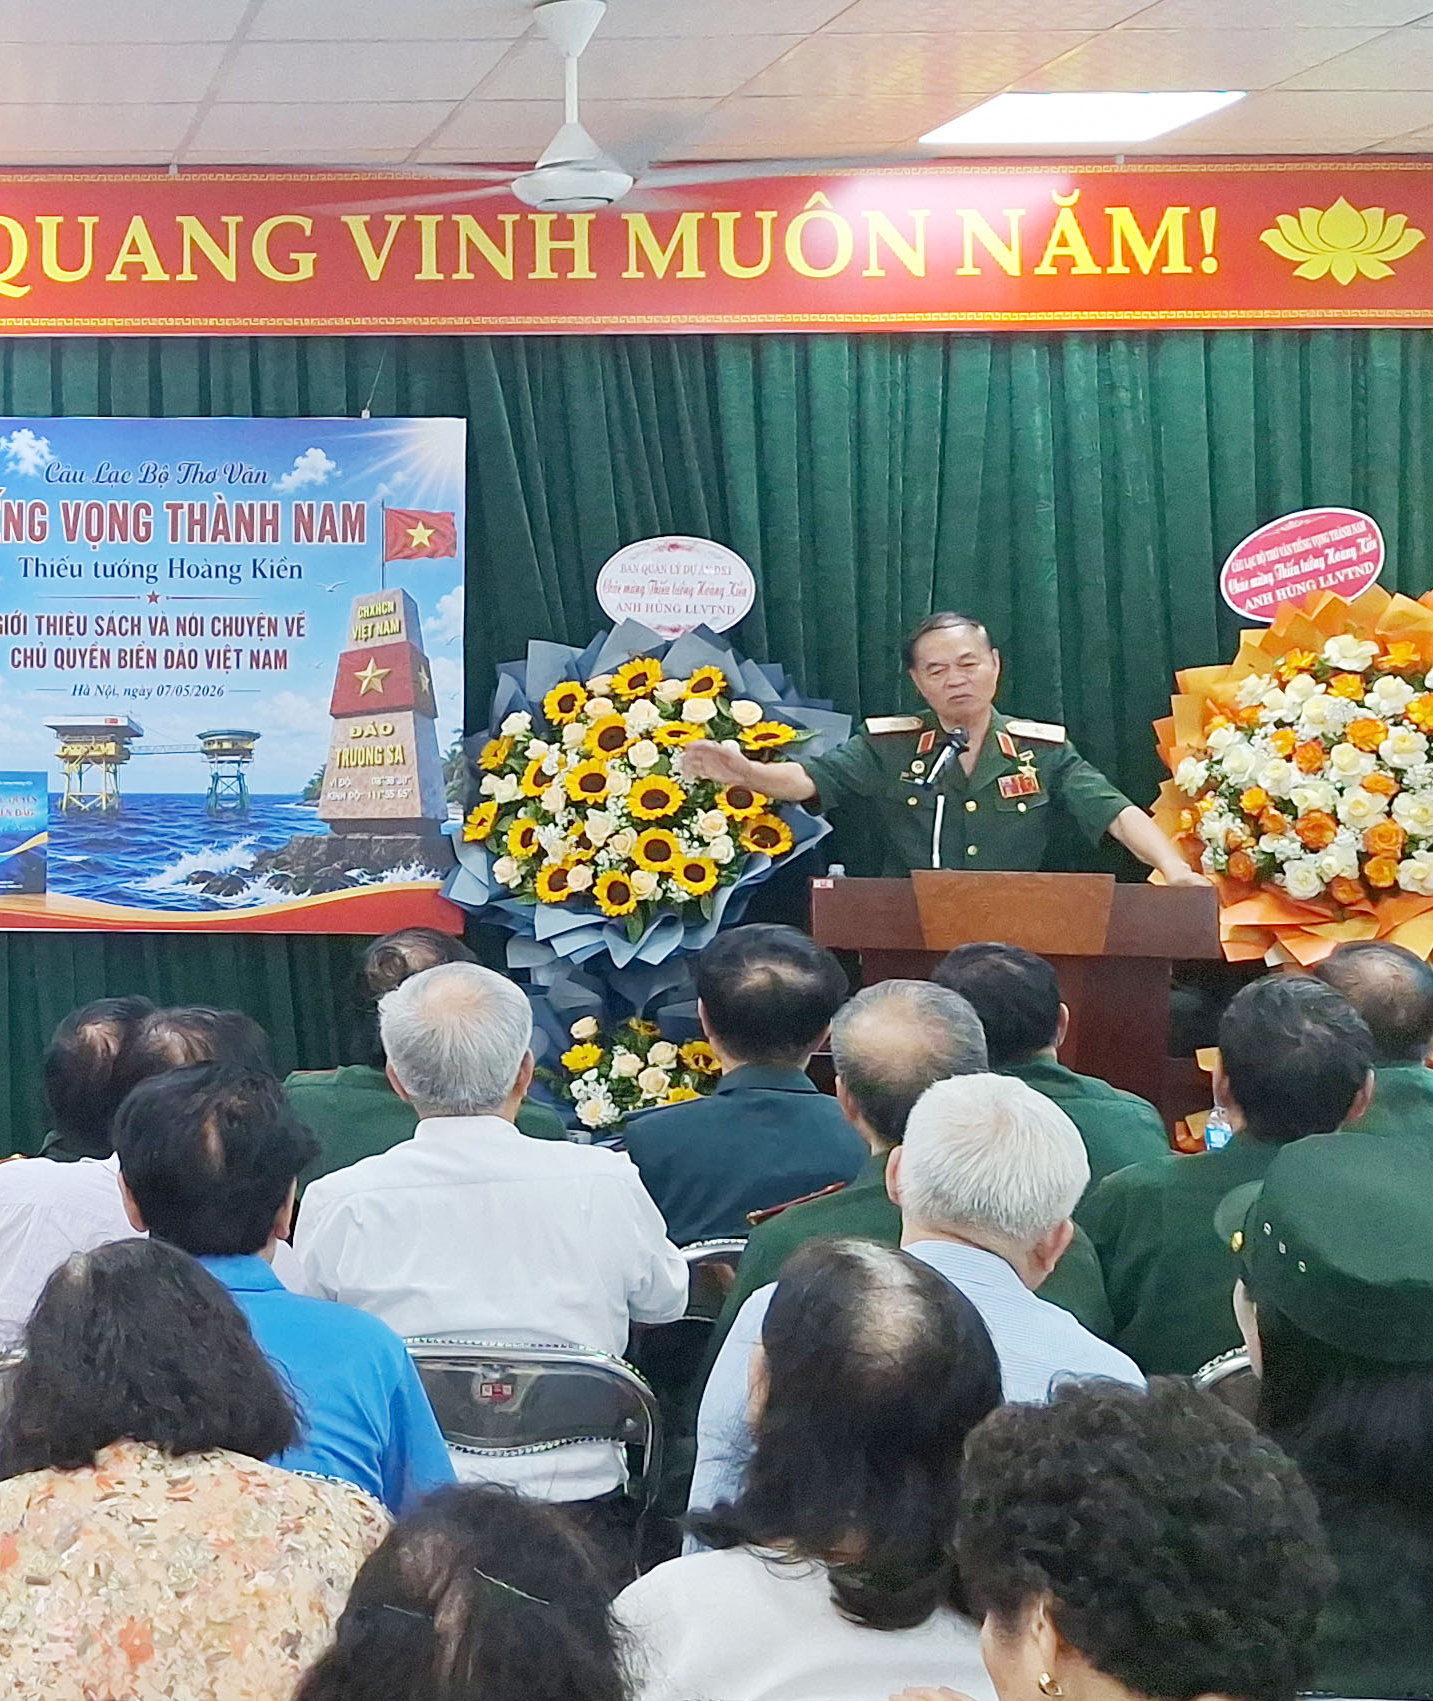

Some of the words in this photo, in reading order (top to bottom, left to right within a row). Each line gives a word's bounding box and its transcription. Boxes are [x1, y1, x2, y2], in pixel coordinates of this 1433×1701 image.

[341, 213, 597, 281] VINH
[620, 190, 929, 279] MUÔN
[956, 188, 1219, 276] NĂM!
[91, 462, 133, 487] Lạc
[138, 462, 170, 487] Bộ
[177, 461, 220, 484] Thơ
[223, 461, 269, 484] Văn
[61, 500, 153, 550] VỌNG
[164, 492, 280, 545] THÀNH
[293, 500, 367, 545] NAM
[18, 556, 83, 579] Thiếu
[93, 557, 159, 585] tướng
[168, 557, 242, 585] Hoàng
[251, 556, 304, 580] Kiền
[1244, 593, 1274, 612] ANH
[1276, 579, 1317, 602] HÙNG
[1319, 561, 1375, 589] LLVTND
[357, 600, 396, 620] CHXHCN
[685, 604, 735, 615] LLVTND
[35, 611, 88, 641] THIỆU
[95, 609, 142, 637] SÁCH
[148, 610, 170, 637] VÀ
[176, 611, 204, 638] NÓI
[211, 612, 279, 641] CHUYỆN
[284, 609, 306, 638] VỀ
[352, 622, 375, 642] VIỆT
[376, 619, 401, 636] NAM
[10, 641, 46, 669] CHỦ
[53, 641, 111, 670] QUYỀN
[163, 642, 198, 670] ĐẢO
[205, 643, 243, 675] VIỆT
[249, 648, 288, 670] NAM
[71, 683, 91, 698] Hà
[94, 683, 120, 700] Nội,
[123, 686, 153, 700] ngày
[156, 684, 225, 698] 07/05/2026
[387, 744, 406, 766] SA
